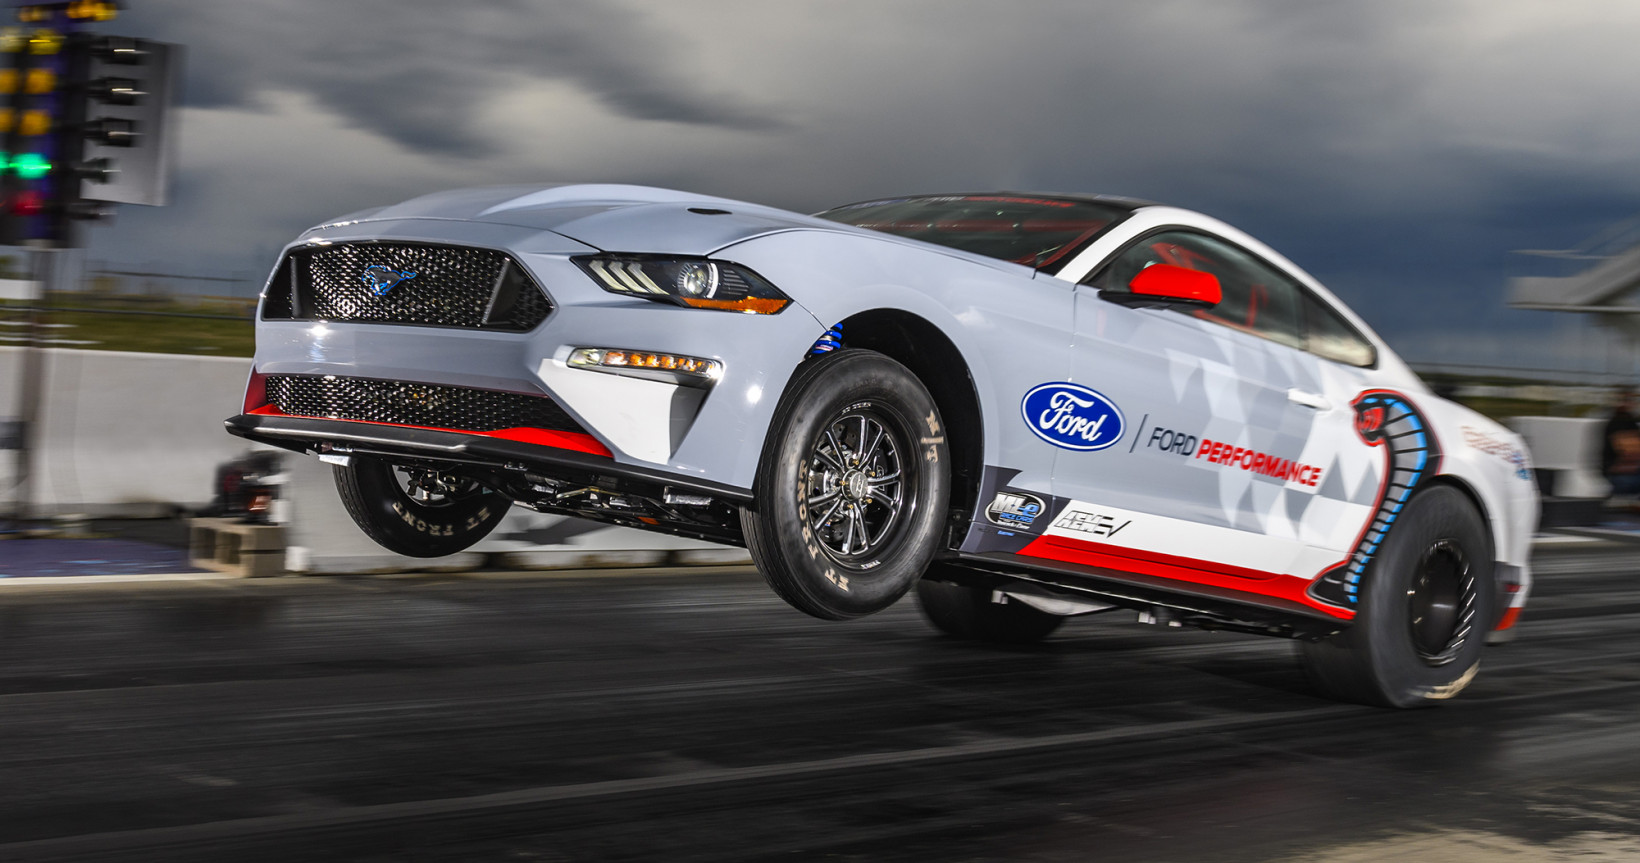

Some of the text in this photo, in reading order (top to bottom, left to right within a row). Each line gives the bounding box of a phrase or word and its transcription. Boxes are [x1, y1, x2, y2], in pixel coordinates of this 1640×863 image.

[1040, 391, 1108, 441] Ford
[1147, 427, 1323, 487] FORD PERFORMANCE
[392, 501, 454, 536] FRONT
[797, 459, 819, 560] FRONT
